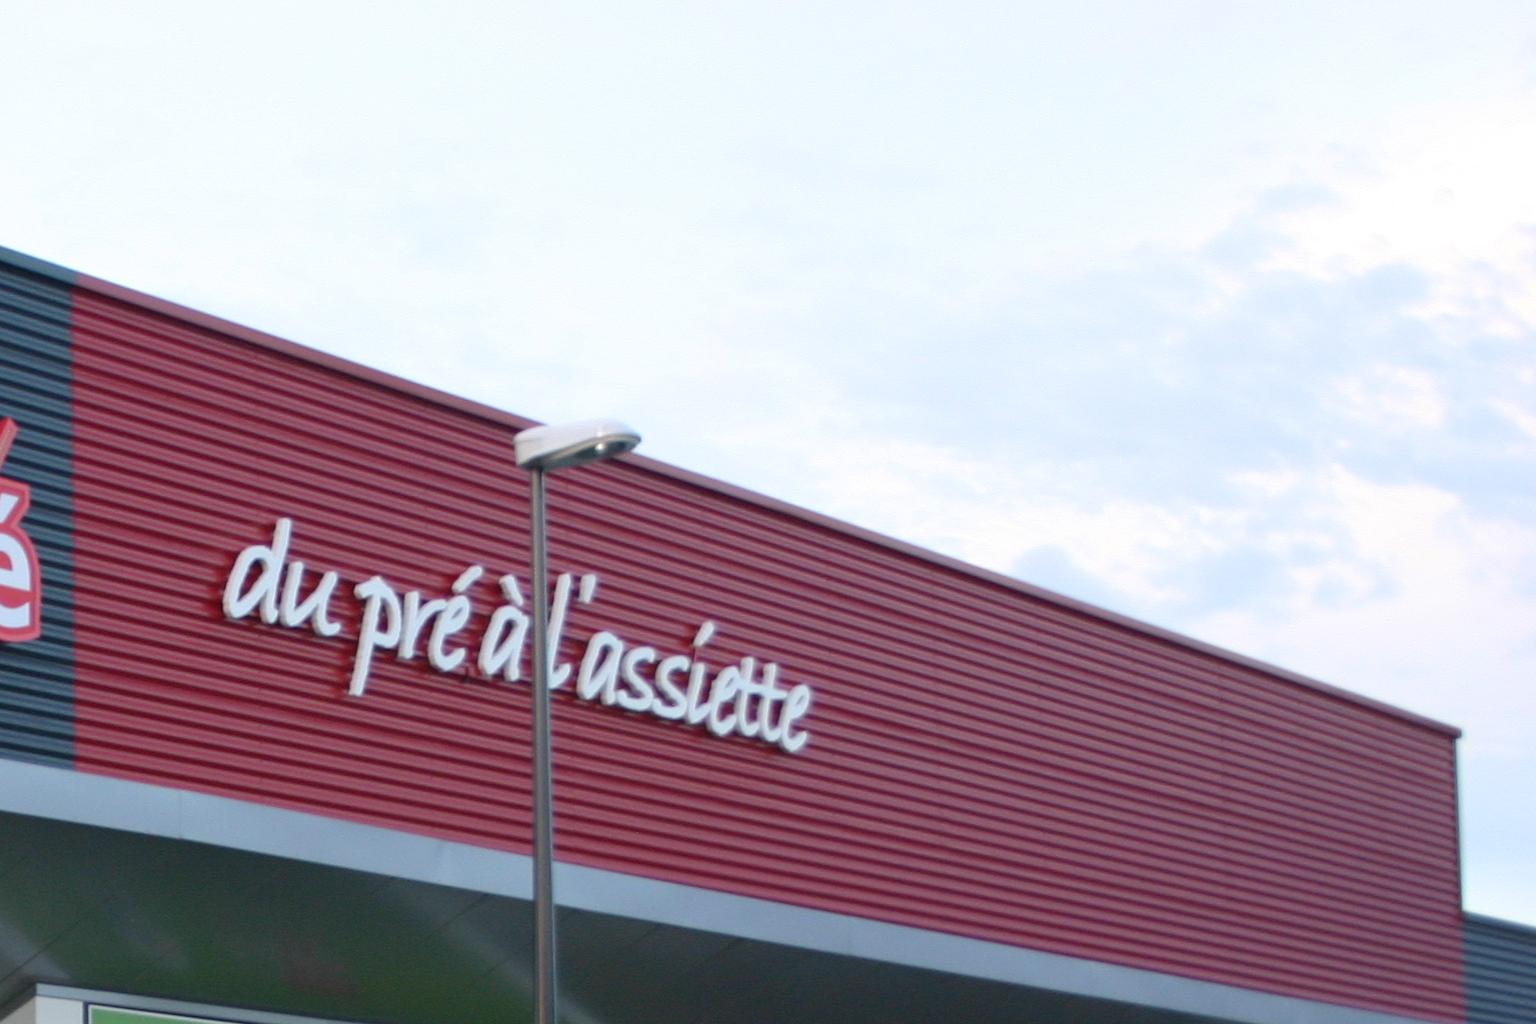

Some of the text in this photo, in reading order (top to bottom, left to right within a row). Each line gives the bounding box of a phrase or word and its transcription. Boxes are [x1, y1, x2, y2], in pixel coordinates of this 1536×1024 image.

[222, 517, 341, 637] du
[350, 564, 483, 697] pré
[478, 574, 531, 682] à
